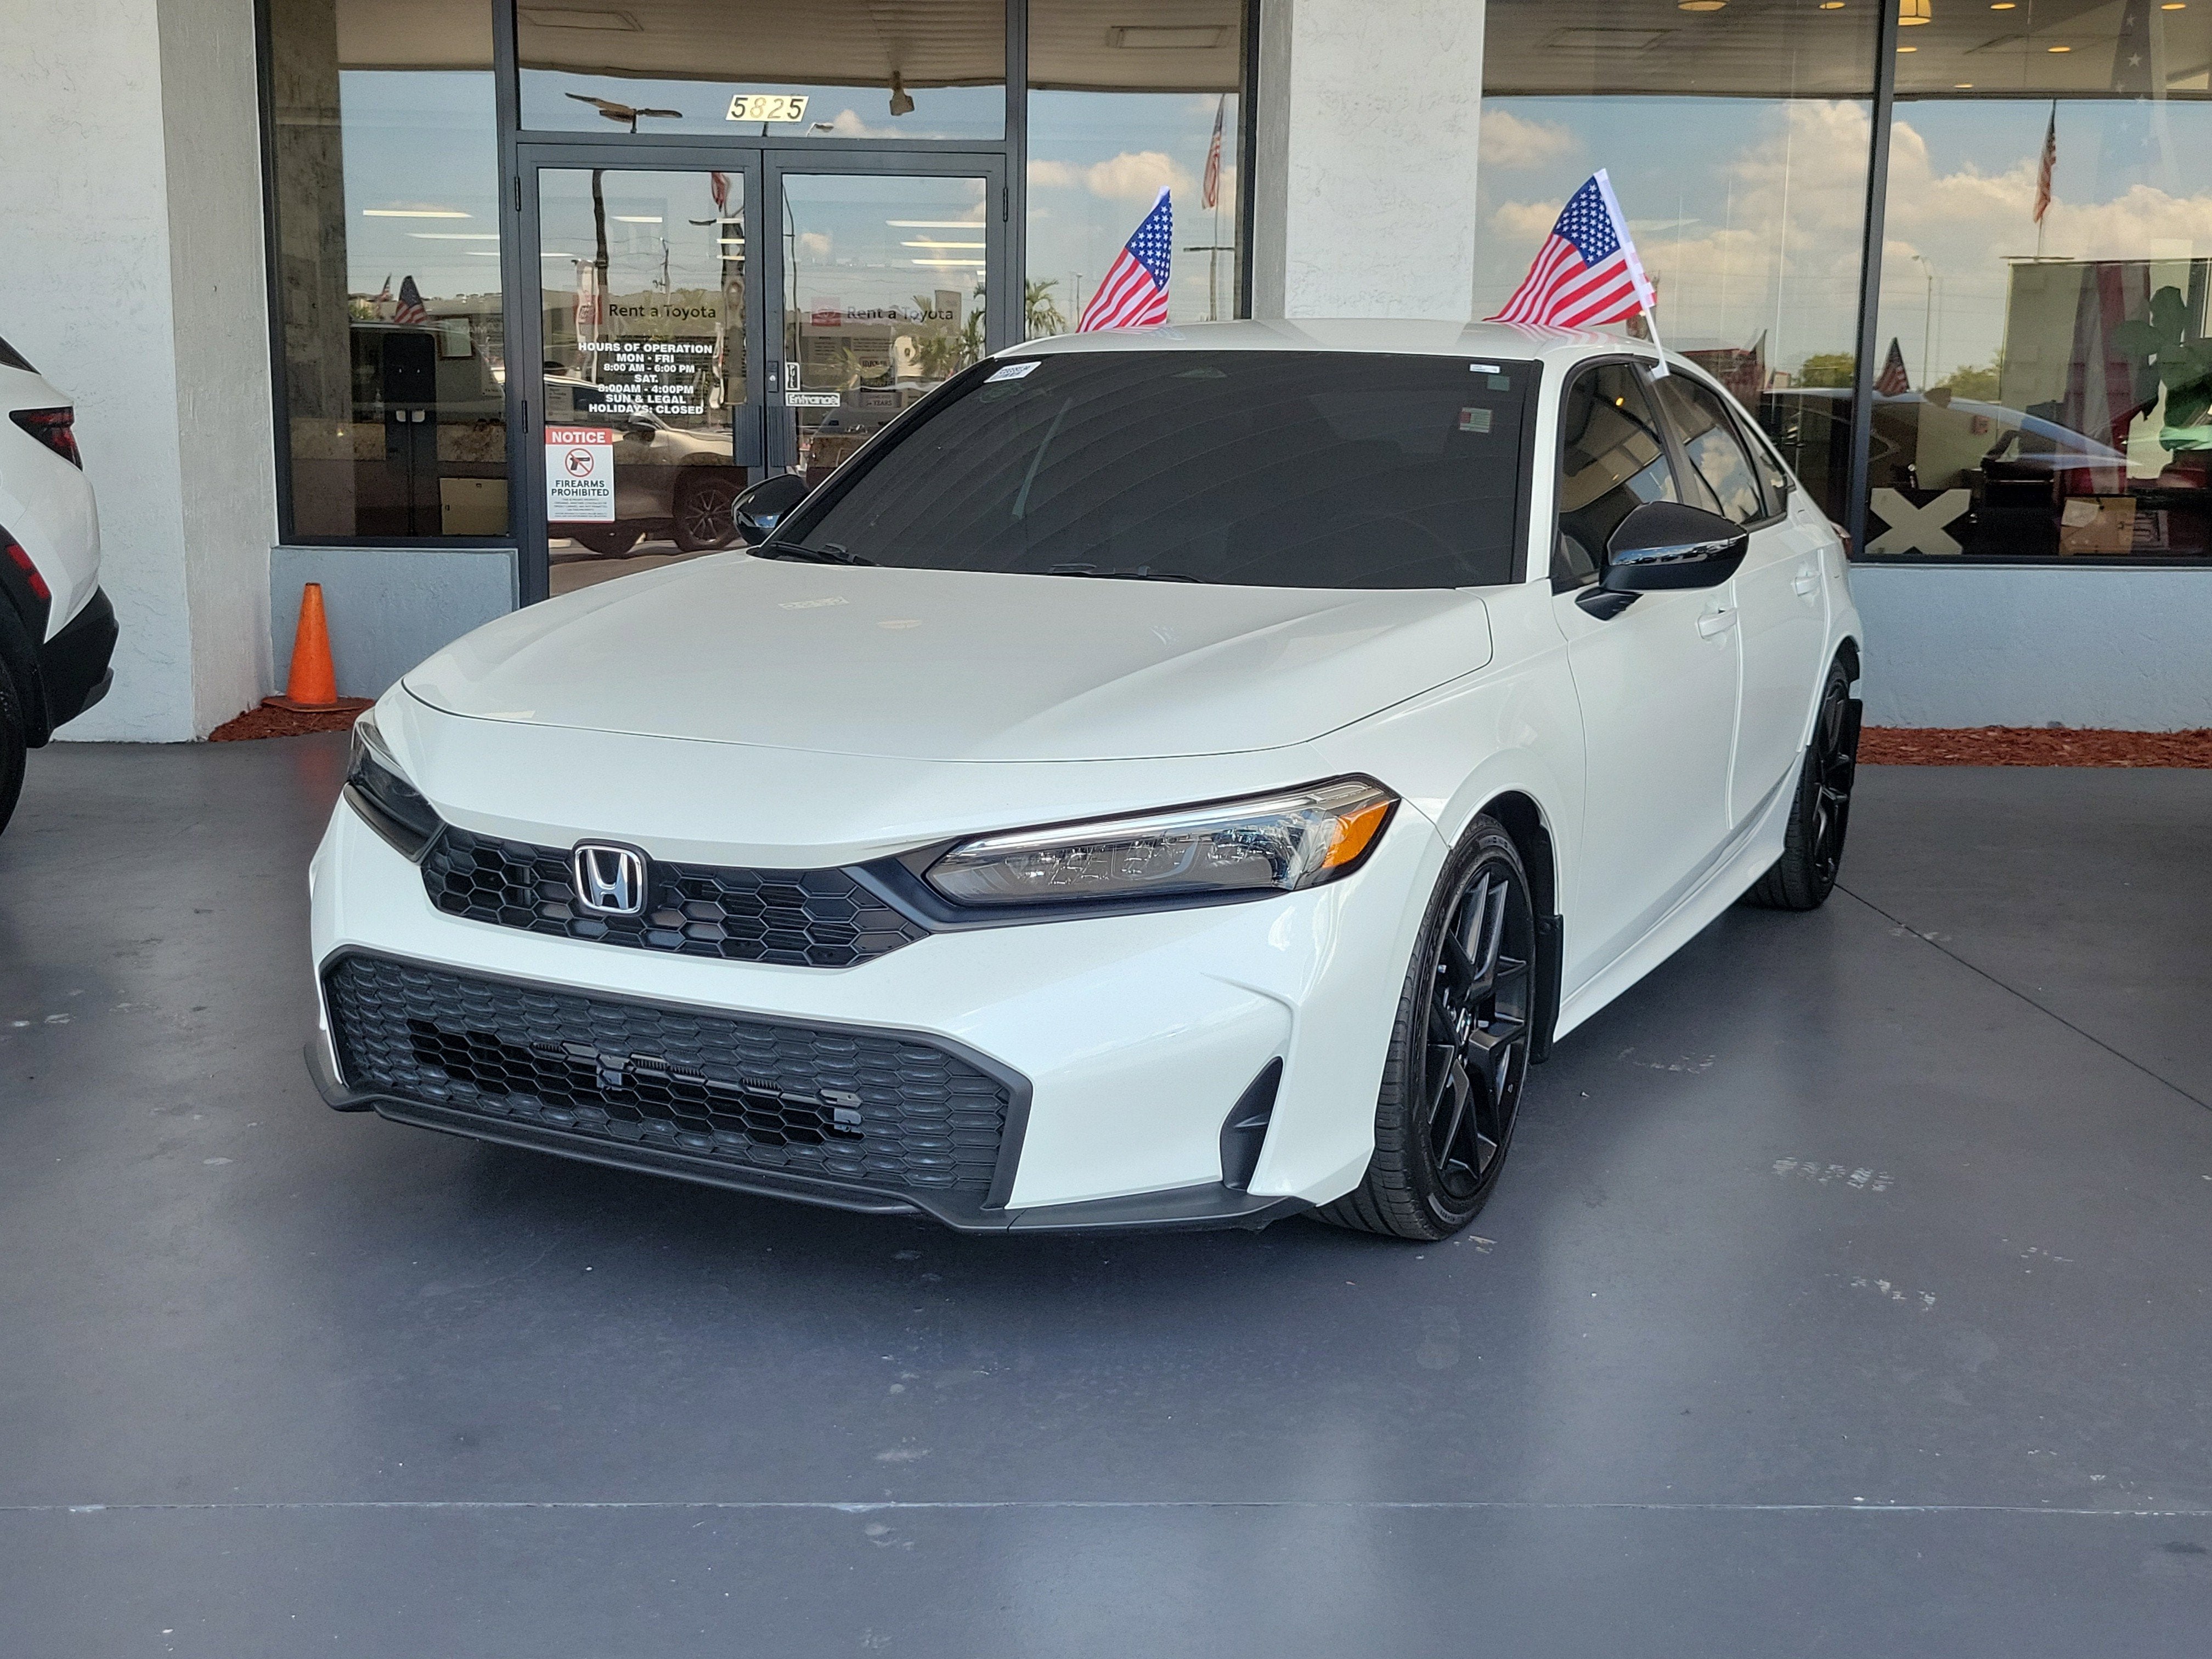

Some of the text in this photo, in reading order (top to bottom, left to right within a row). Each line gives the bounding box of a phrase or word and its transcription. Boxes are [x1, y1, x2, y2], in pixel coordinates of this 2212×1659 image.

[731, 97, 804, 120] 5825
[609, 304, 716, 320] Rent a Toyota
[848, 307, 953, 323] Rent a Toyota
[579, 342, 713, 354] HOURS OF OPERATION
[616, 354, 644, 363] MON
[654, 354, 674, 363] FRI
[654, 364, 676, 373] 6:00
[679, 365, 695, 373] PM
[634, 374, 658, 383] SAT.
[598, 385, 641, 393] 8:00AM
[651, 385, 694, 394] 4:00PM
[606, 394, 686, 404] SUN & LEGAL
[789, 394, 837, 405] Entrance
[589, 404, 704, 415] HOLIDAYS: CLOSED
[552, 431, 606, 443] NOTICE
[551, 488, 610, 496] PROHIBITED
